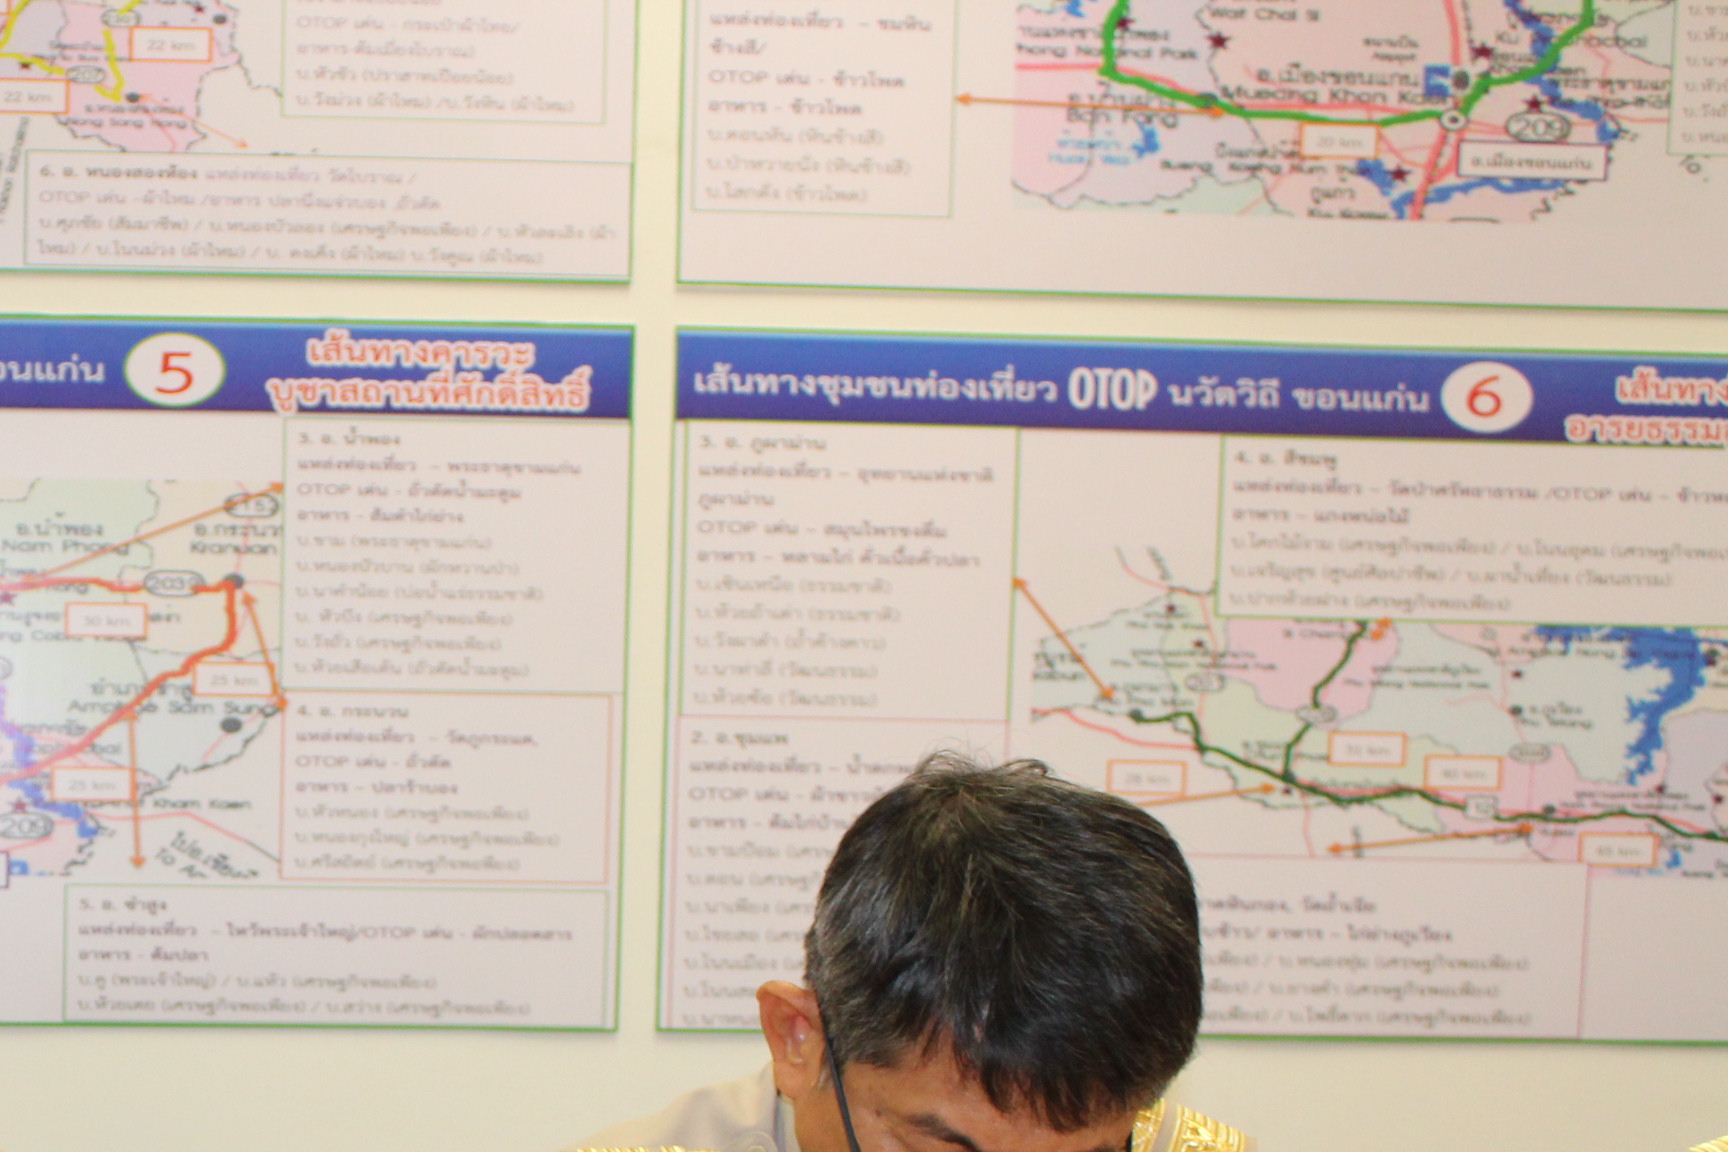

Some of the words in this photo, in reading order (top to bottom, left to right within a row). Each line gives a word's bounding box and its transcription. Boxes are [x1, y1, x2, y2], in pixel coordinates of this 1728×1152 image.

[304, 327, 538, 369] เส้นทางคารวะ
[155, 351, 194, 395] 5
[693, 361, 1059, 408] เส้นทางชุมชนท่องเที่ยว
[1067, 365, 1159, 412] OTOP
[1167, 375, 1282, 410] นวัตวิถี
[1291, 381, 1432, 413] ขอนแก่น
[1466, 375, 1503, 418] 6
[1563, 413, 1728, 445] อารยธรรม
